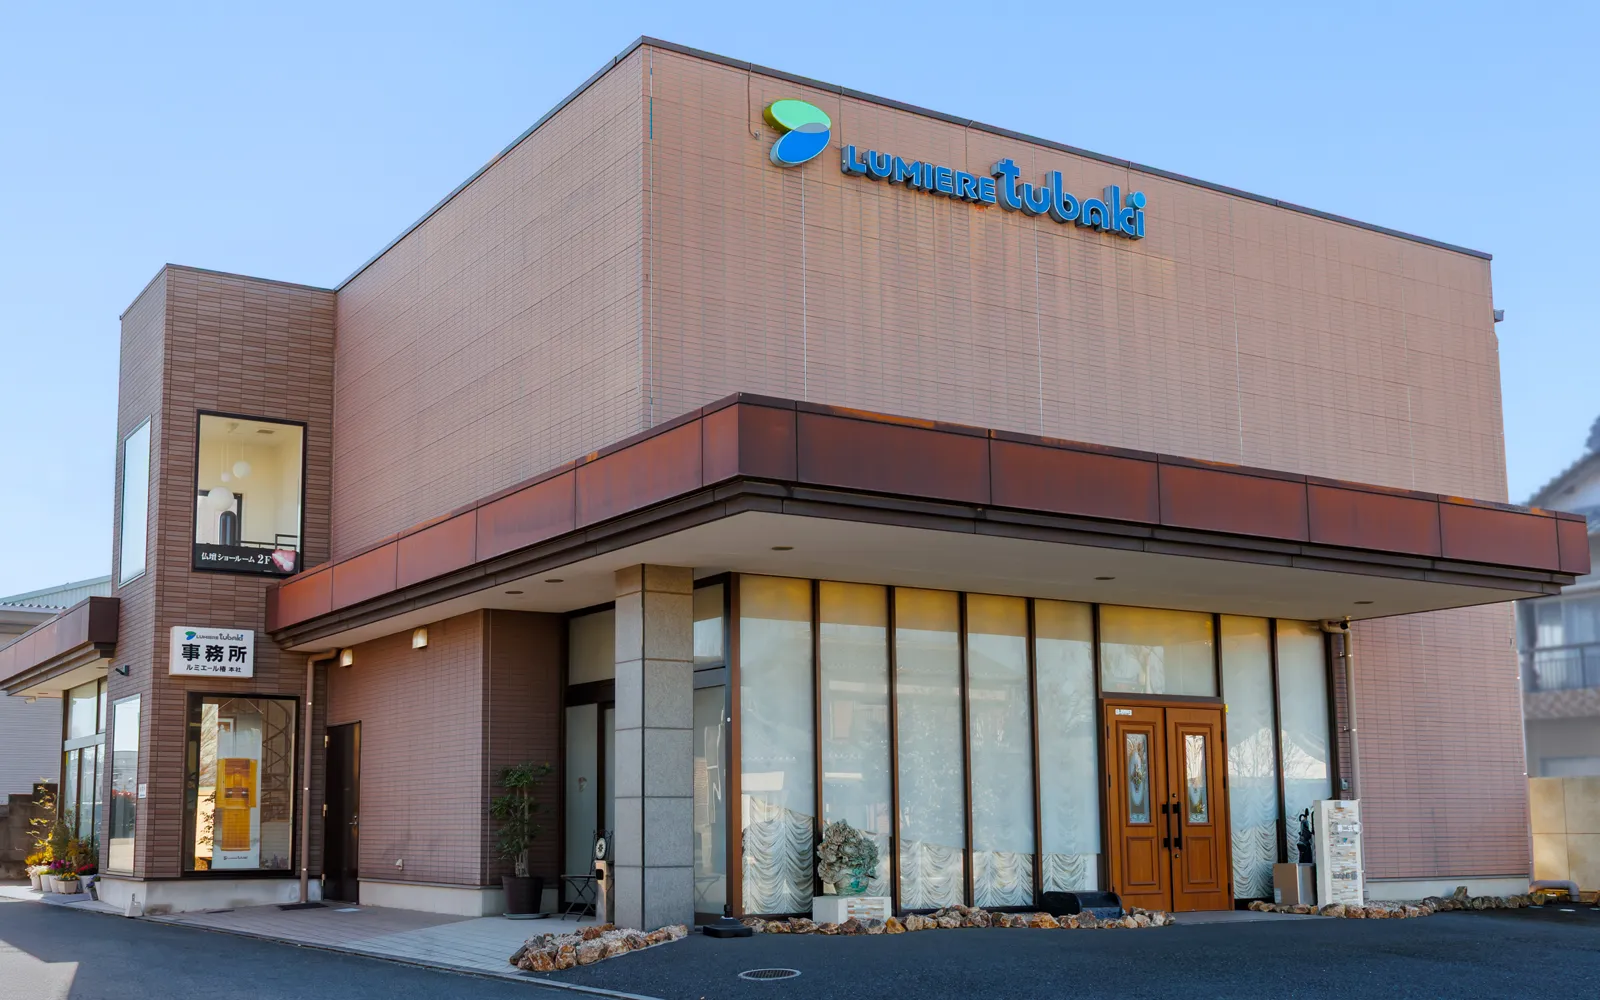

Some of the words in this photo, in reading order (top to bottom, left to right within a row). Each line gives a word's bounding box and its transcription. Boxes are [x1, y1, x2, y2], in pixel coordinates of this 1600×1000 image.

[842, 144, 997, 206] LUMIERE
[992, 157, 1147, 240] tubaki
[201, 552, 255, 563] 仏壇ショールーム
[257, 553, 272, 565] 2F
[181, 643, 247, 664] 事務所
